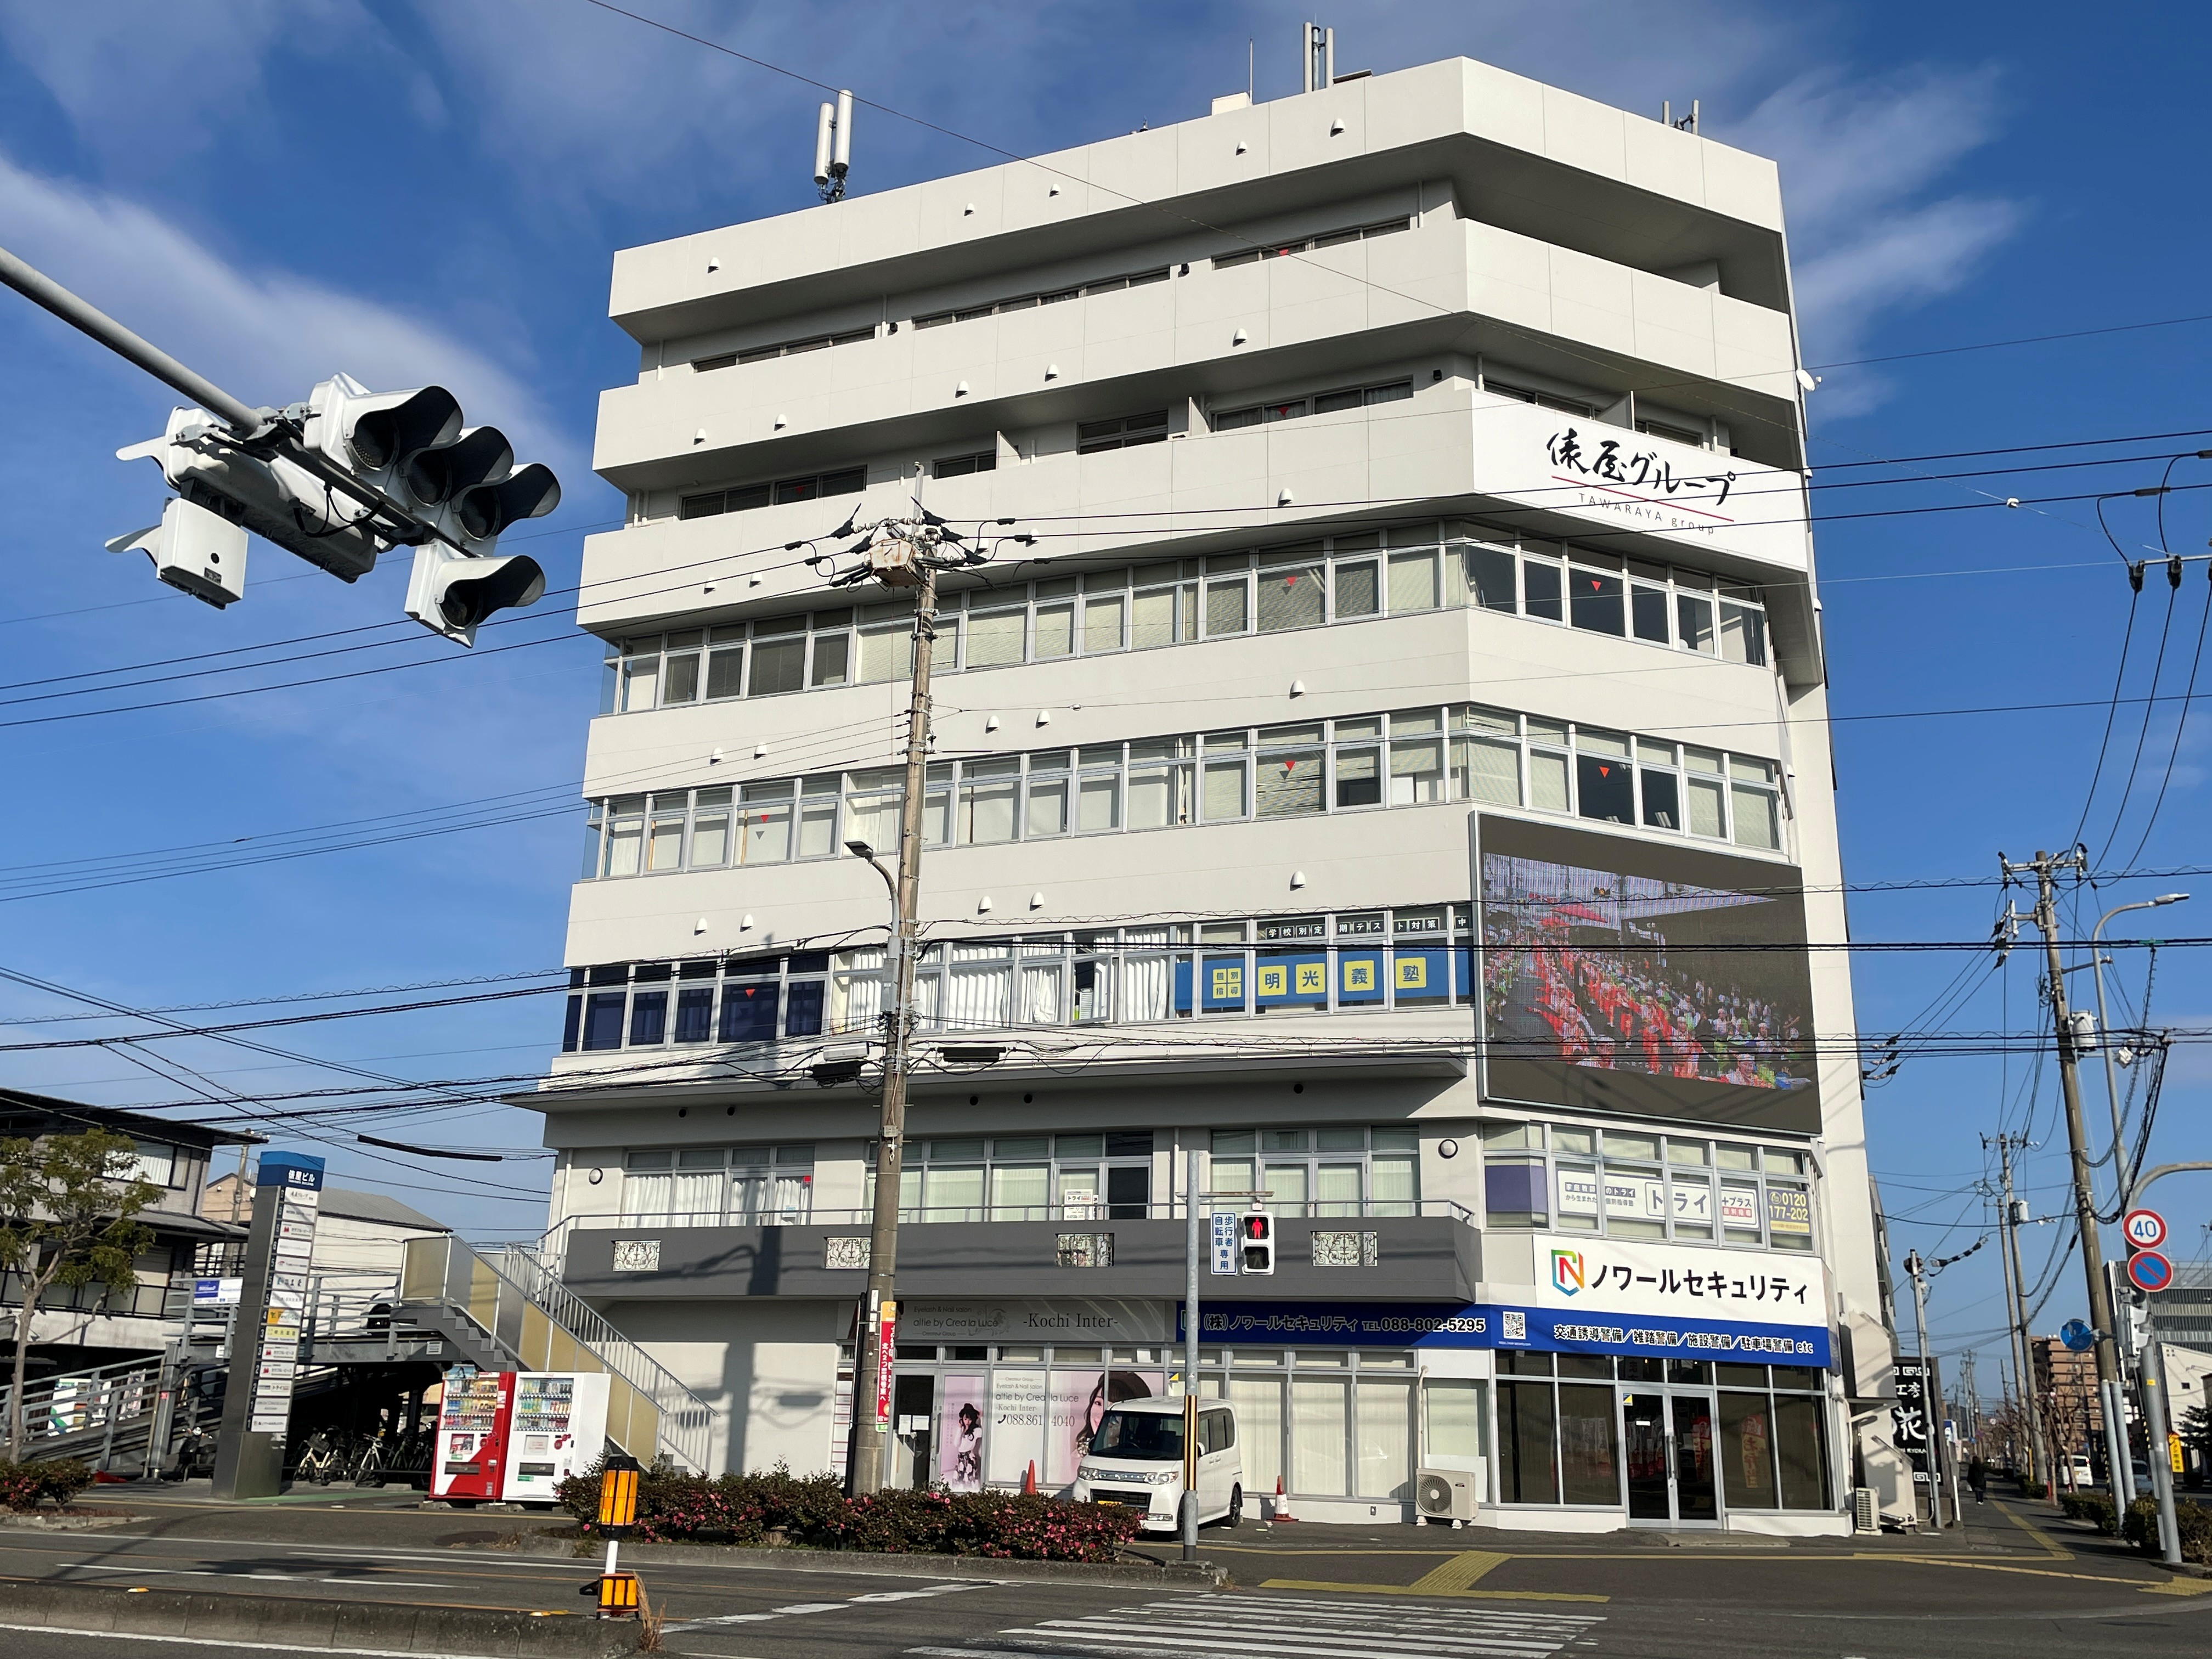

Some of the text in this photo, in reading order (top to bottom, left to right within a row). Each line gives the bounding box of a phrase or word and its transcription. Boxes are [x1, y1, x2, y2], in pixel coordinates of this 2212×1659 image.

[1547, 427, 1736, 506] 俵屋グループ
[1578, 493, 1714, 534] TAWARAYA group
[1265, 965, 1420, 989] 明光義塾
[1652, 1189, 1707, 1214] トライ
[1782, 1192, 1807, 1207] 0120
[1769, 1205, 1809, 1221] 177-202
[1215, 1216, 1223, 1247] 自転車
[1224, 1216, 1233, 1247] 歩行者
[2134, 1221, 2157, 1238] 40
[1591, 1265, 1807, 1305] ノワールセキュリティ
[933, 1318, 944, 1329] by
[945, 1318, 966, 1327] Crea
[968, 1318, 976, 1327] la
[978, 1318, 998, 1328] Luce
[1362, 1321, 1381, 1331] TEL
[1381, 1317, 1486, 1333] 088-802-5295
[1796, 1340, 1814, 1355] etc
[1014, 1393, 1024, 1402] by
[1026, 1393, 1046, 1402] Crea
[1059, 1394, 1079, 1402] Luce
[1051, 1415, 1075, 1426] 4040
